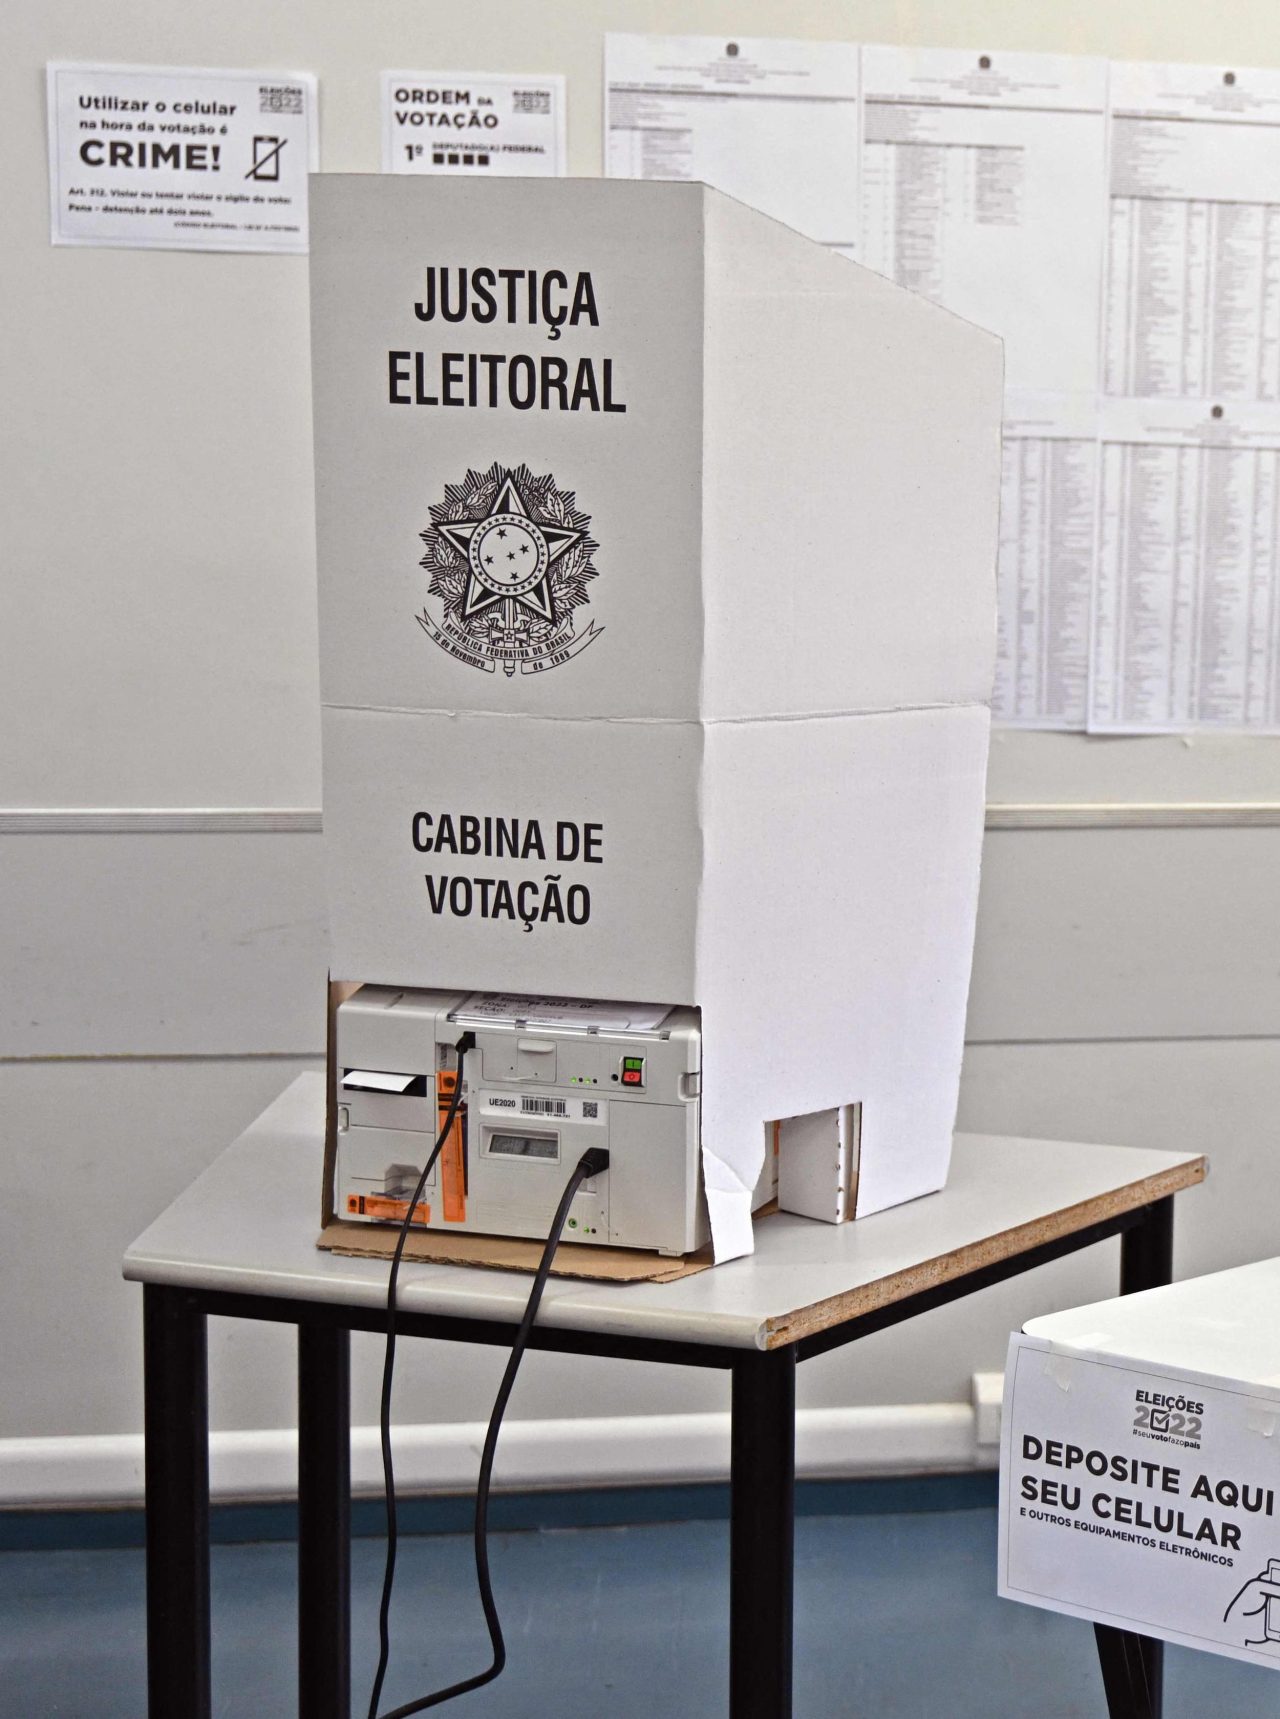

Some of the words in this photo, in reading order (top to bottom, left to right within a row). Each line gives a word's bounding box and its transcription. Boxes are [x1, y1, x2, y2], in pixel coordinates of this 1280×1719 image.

[78, 96, 149, 112] Utilizar
[155, 102, 167, 113] o
[173, 99, 237, 116] celular
[395, 89, 470, 105] ORDEM
[476, 96, 493, 106] DA
[79, 120, 97, 130] na
[101, 118, 133, 132] hora
[138, 119, 154, 132] da
[159, 121, 215, 136] votação
[219, 124, 228, 136] é
[395, 109, 499, 130] VOTAÇÃO
[80, 139, 221, 172] CRIME!
[414, 266, 600, 341] JUSTIÇA
[388, 350, 627, 413] ELEITORAL
[433, 631, 442, 640] 15
[450, 646, 486, 668] Novembro
[486, 646, 530, 658] FEDERATIVA
[532, 646, 543, 656] DO
[545, 632, 572, 651] BRASIL
[412, 811, 546, 860] CABINA
[556, 820, 604, 864] DE
[425, 874, 591, 933] VOTAÇÃO
[489, 1098, 516, 1108] UE2020
[1136, 1389, 1204, 1415] ELEIÇÕES
[1022, 1434, 1180, 1494] DEPOSITE
[1190, 1474, 1274, 1516] AQUI
[1020, 1475, 1080, 1512] SEU
[1092, 1492, 1242, 1551] CELULAR
[1020, 1507, 1027, 1516] E
[1028, 1510, 1072, 1528] OUTROS
[1074, 1520, 1156, 1548] EQUIPAMENTOS
[1159, 1540, 1234, 1568] ELETRÔNICOS
